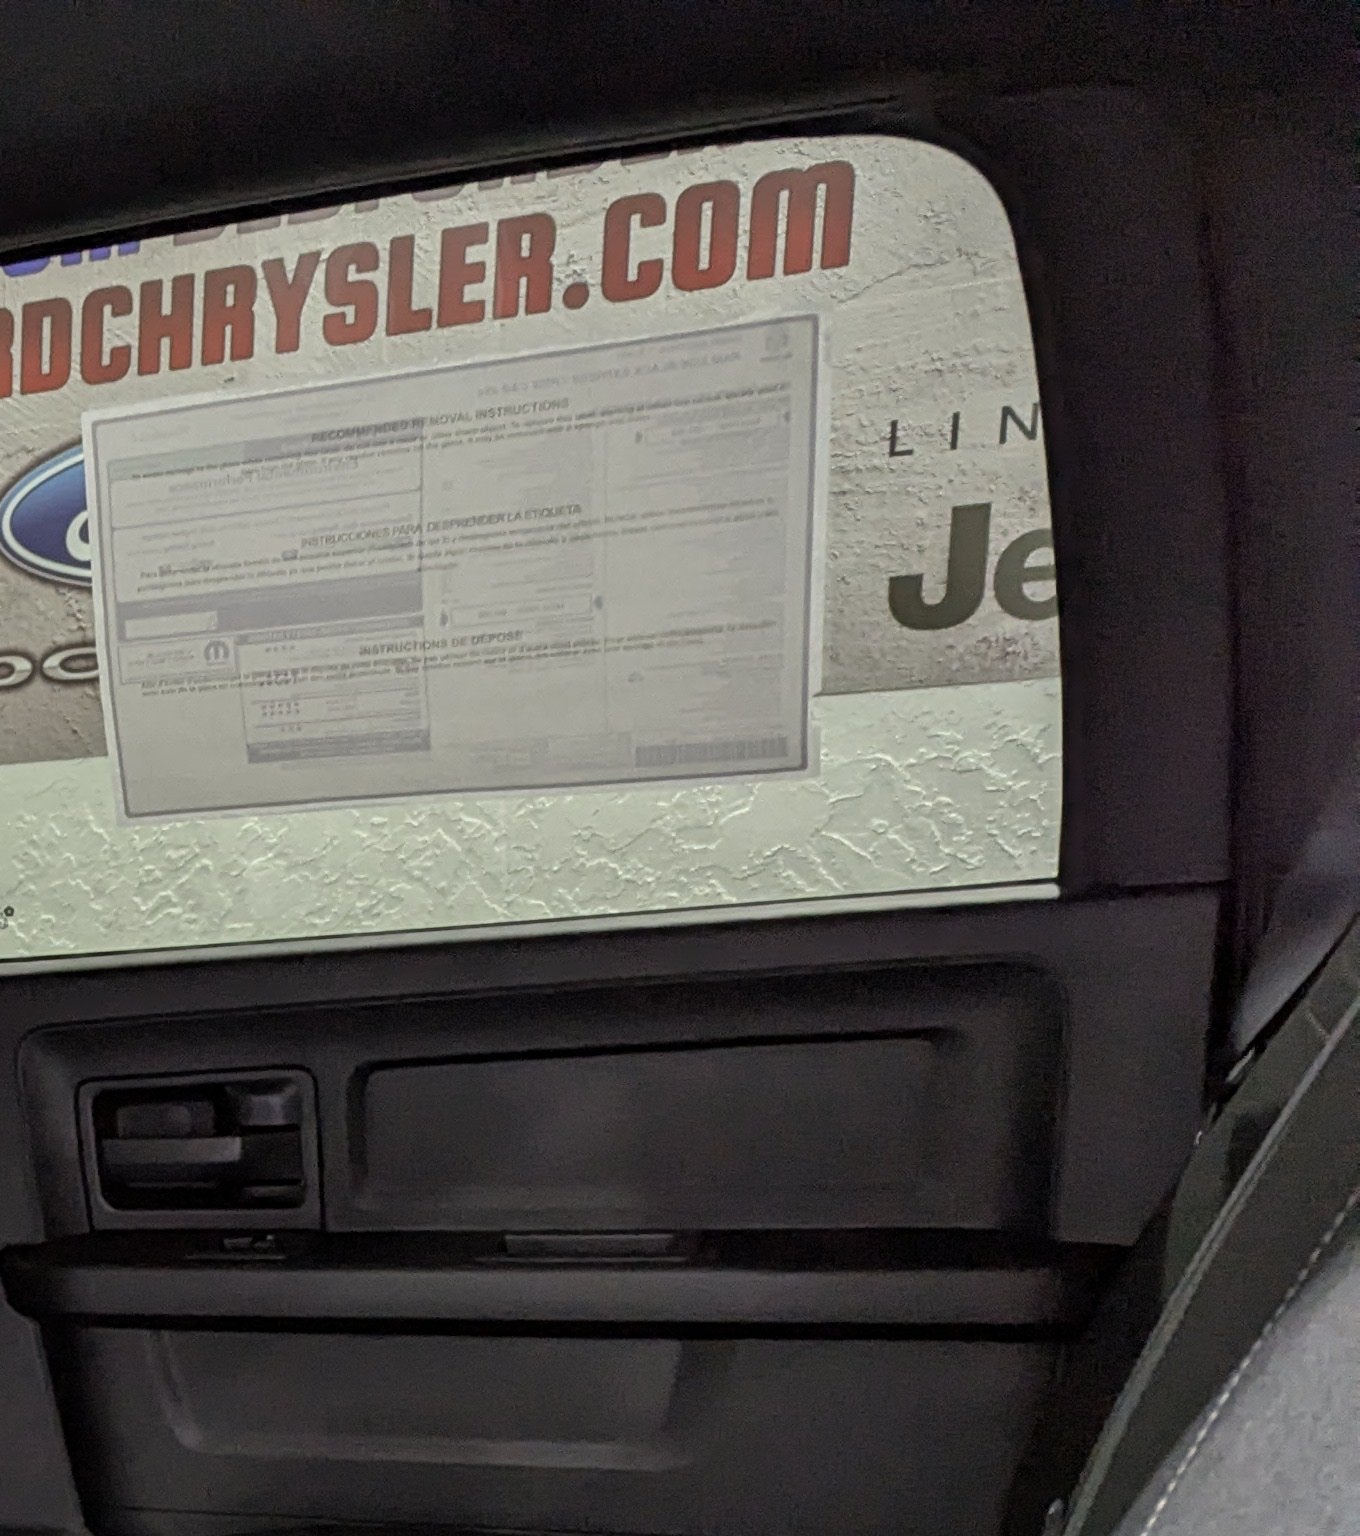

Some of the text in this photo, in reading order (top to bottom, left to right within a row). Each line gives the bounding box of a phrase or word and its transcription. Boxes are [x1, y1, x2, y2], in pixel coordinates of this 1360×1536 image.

[309, 419, 412, 442] RECOMMENDED
[474, 397, 569, 420] INSTRUCTIONS
[889, 403, 1040, 457] LIN
[300, 526, 390, 547] INSTRUCCIONES
[391, 522, 422, 536] PARA
[425, 512, 505, 532] DESPRENDER
[505, 510, 522, 522] LA
[523, 503, 582, 520] ETIQUETA
[358, 637, 447, 656] INSTRUCTIONS
[450, 635, 468, 647] DE
